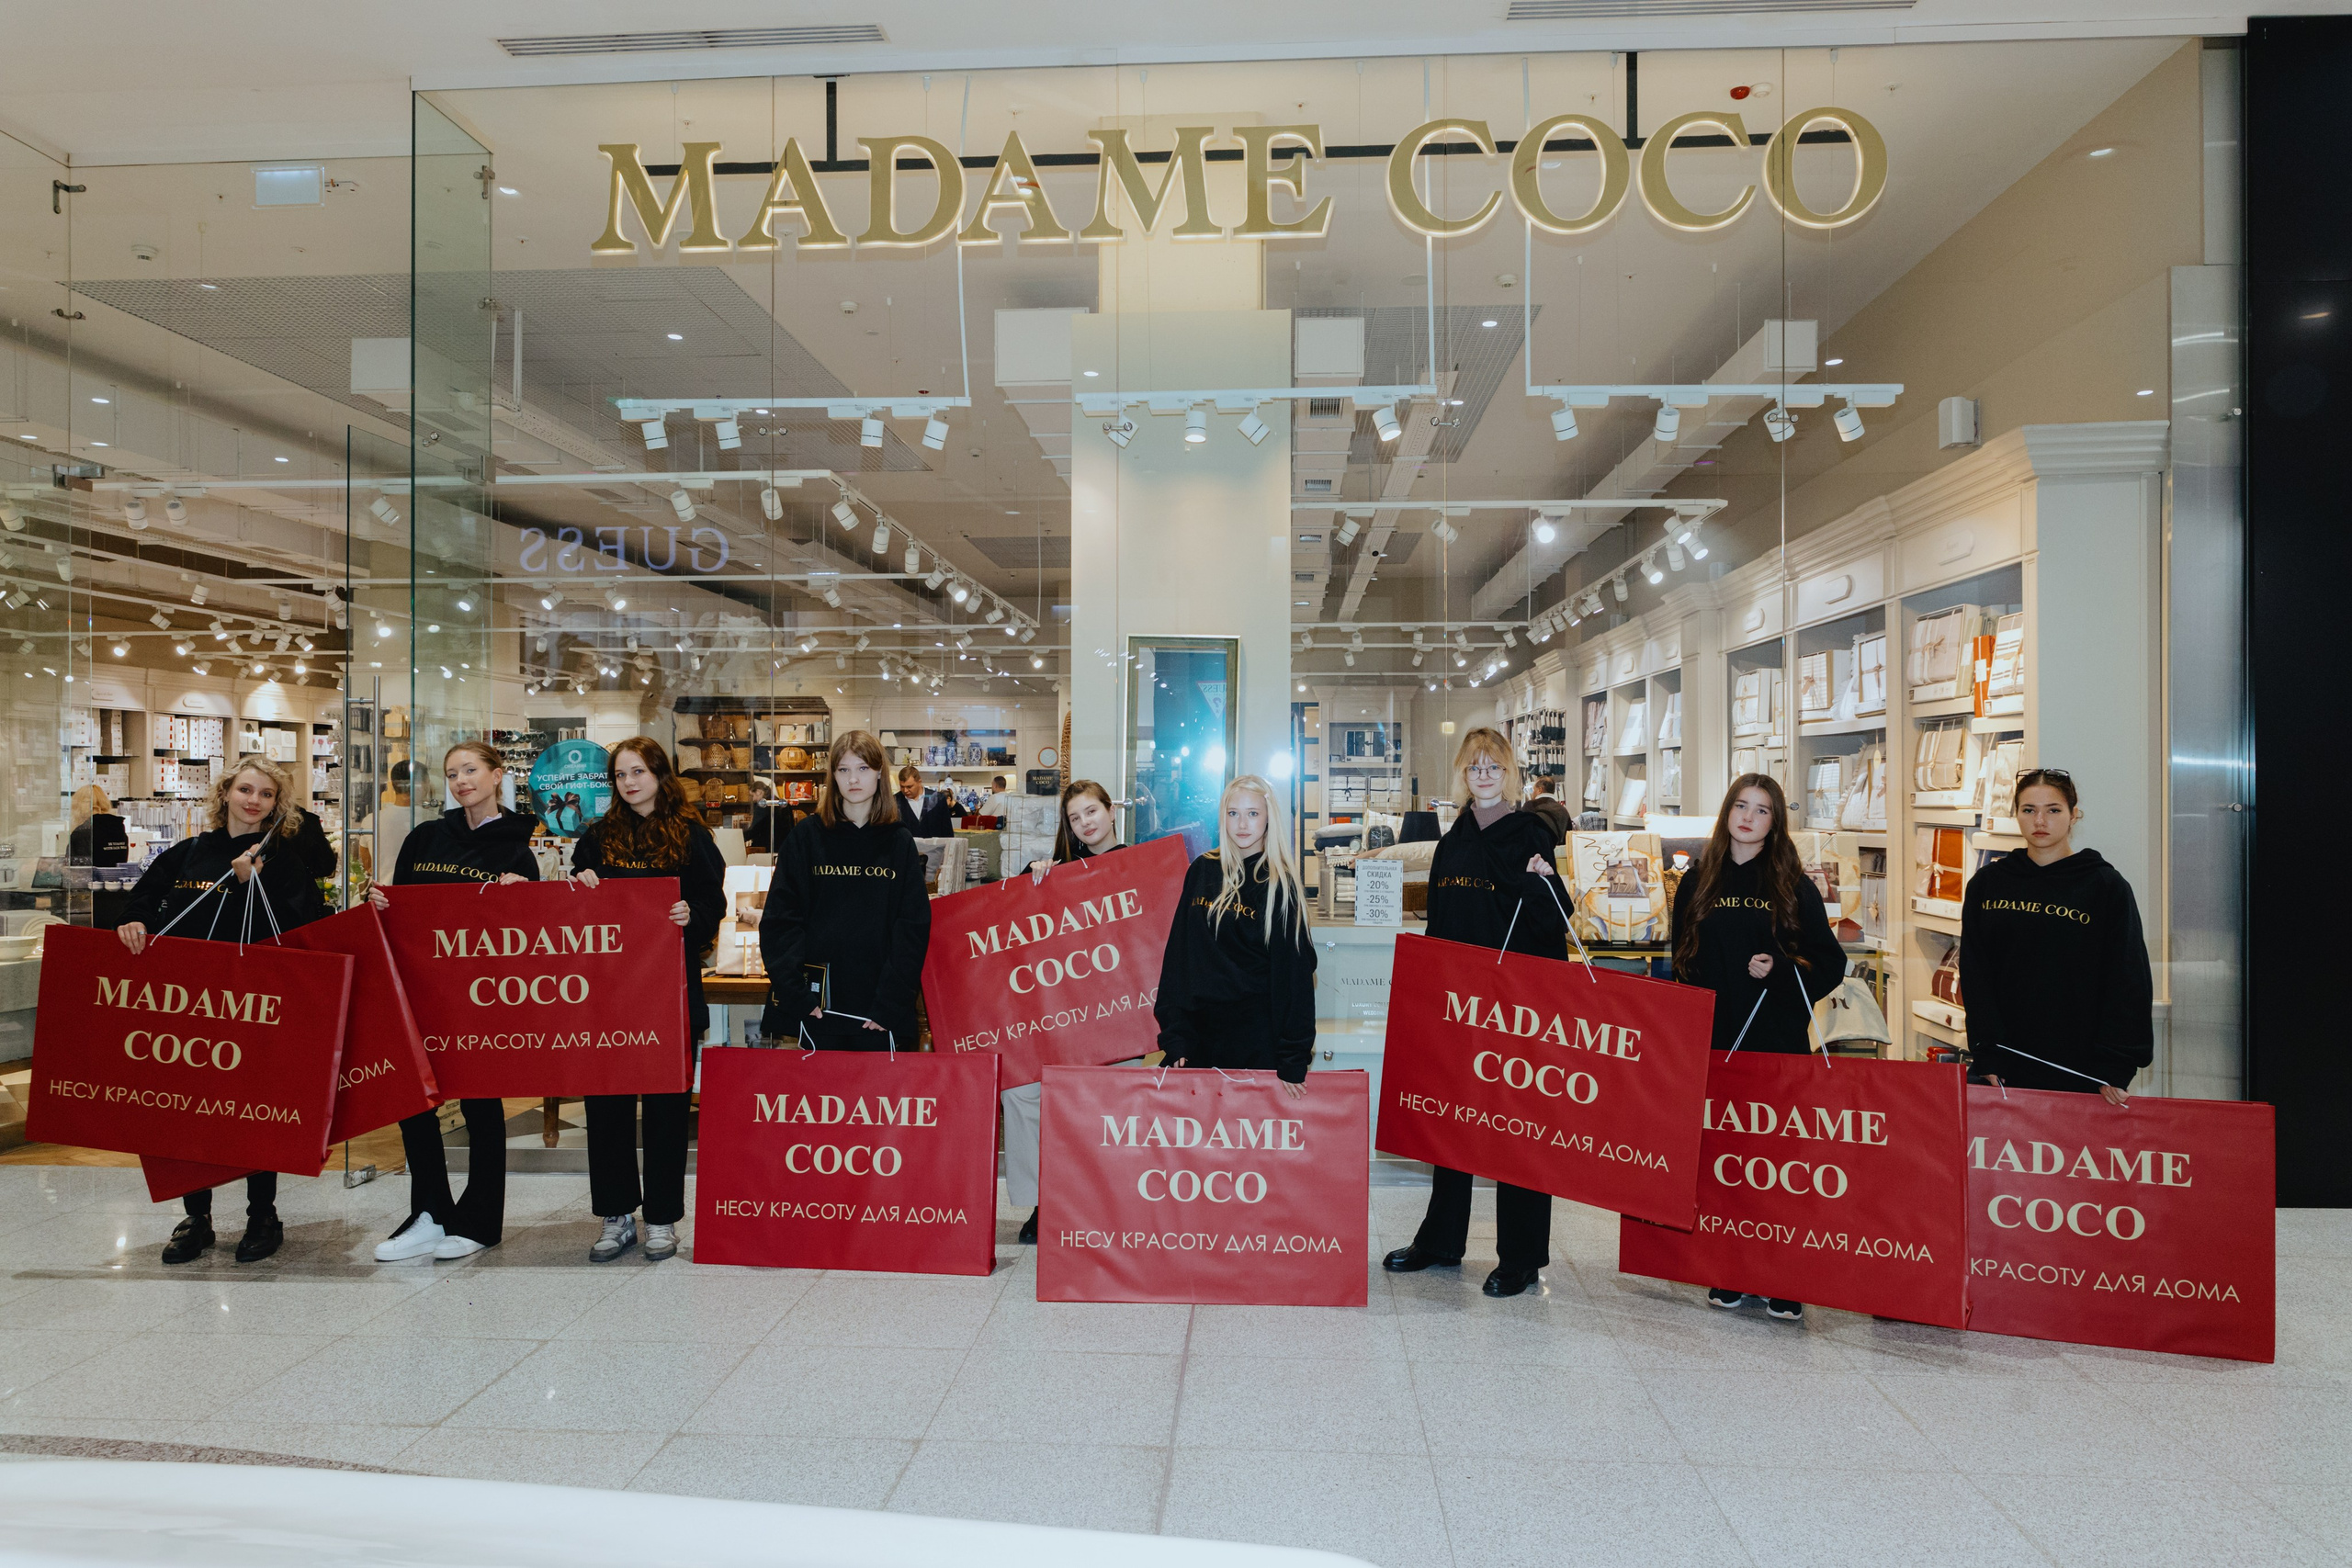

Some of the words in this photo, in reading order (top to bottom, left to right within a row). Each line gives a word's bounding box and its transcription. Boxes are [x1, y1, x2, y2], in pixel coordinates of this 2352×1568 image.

[591, 124, 1331, 256] MADAME
[1385, 106, 1888, 238] COCO
[537, 772, 575, 782] УСПЕЙТЕ
[577, 772, 608, 780] ЗАБРАТ
[539, 781, 563, 791] СВОЙ
[1366, 895, 1388, 904] -25%
[1367, 880, 1389, 889] -20%
[1366, 908, 1388, 918] -30%
[1744, 897, 1773, 910] COC
[2044, 904, 2091, 925] COCO
[966, 888, 1142, 958] MADAME
[433, 924, 623, 958] MADAME
[1010, 943, 1120, 993] COCO
[94, 976, 281, 1025] MADAME
[469, 975, 589, 1006] COCO
[954, 1029, 1000, 1054] НЕСУ
[1006, 1006, 1088, 1040] КРАСОТУ
[1096, 996, 1131, 1020] ДЛЯ
[1137, 987, 1158, 1009] ДО
[1443, 991, 1641, 1061] MADAME
[125, 1031, 241, 1070] COCO
[424, 1036, 450, 1051] СУ
[458, 1033, 545, 1050] КРАСОТУ
[552, 1032, 590, 1049] ДЛЯ
[596, 1031, 660, 1048] ДОМА
[338, 1058, 396, 1091] ДОМА
[1474, 1051, 1598, 1104] COCO
[51, 1080, 99, 1099] НЕСУ
[106, 1087, 192, 1111] КРАСОТУ
[196, 1099, 235, 1116] ДЛЯ
[240, 1103, 300, 1124] ДОМА
[753, 1094, 937, 1126] MADAME
[1100, 1115, 1305, 1150] MADAME
[1400, 1092, 1449, 1116] НЕСУ
[1455, 1105, 1546, 1140] КРАСОТУ
[1551, 1130, 1593, 1153] ДЛЯ
[1599, 1142, 1668, 1172] ДОМА
[786, 1144, 901, 1176] COCO
[1714, 1154, 1848, 1198] COCO
[1137, 1169, 1267, 1203] COCO
[717, 1201, 763, 1216] НЕСУ
[771, 1202, 856, 1220] КРАСОТУ
[861, 1206, 899, 1223] ДЛЯ
[905, 1207, 967, 1224] ДОМА
[1988, 1194, 2145, 1240] COCO
[1061, 1231, 1114, 1248] НЕСУ
[1123, 1232, 1218, 1250] КРАСОТУ
[1225, 1235, 1266, 1253] ДЛЯ
[1273, 1235, 1341, 1254] ДОМА
[1700, 1214, 1795, 1244] КРАСОТУ
[1803, 1230, 1848, 1251] ДЛЯ
[1856, 1236, 1933, 1263] ДОМА
[1971, 1258, 2086, 1286] КРАСОТУ
[2094, 1272, 2144, 1292] ДЛЯ
[2154, 1278, 2240, 1303] ДОМА
